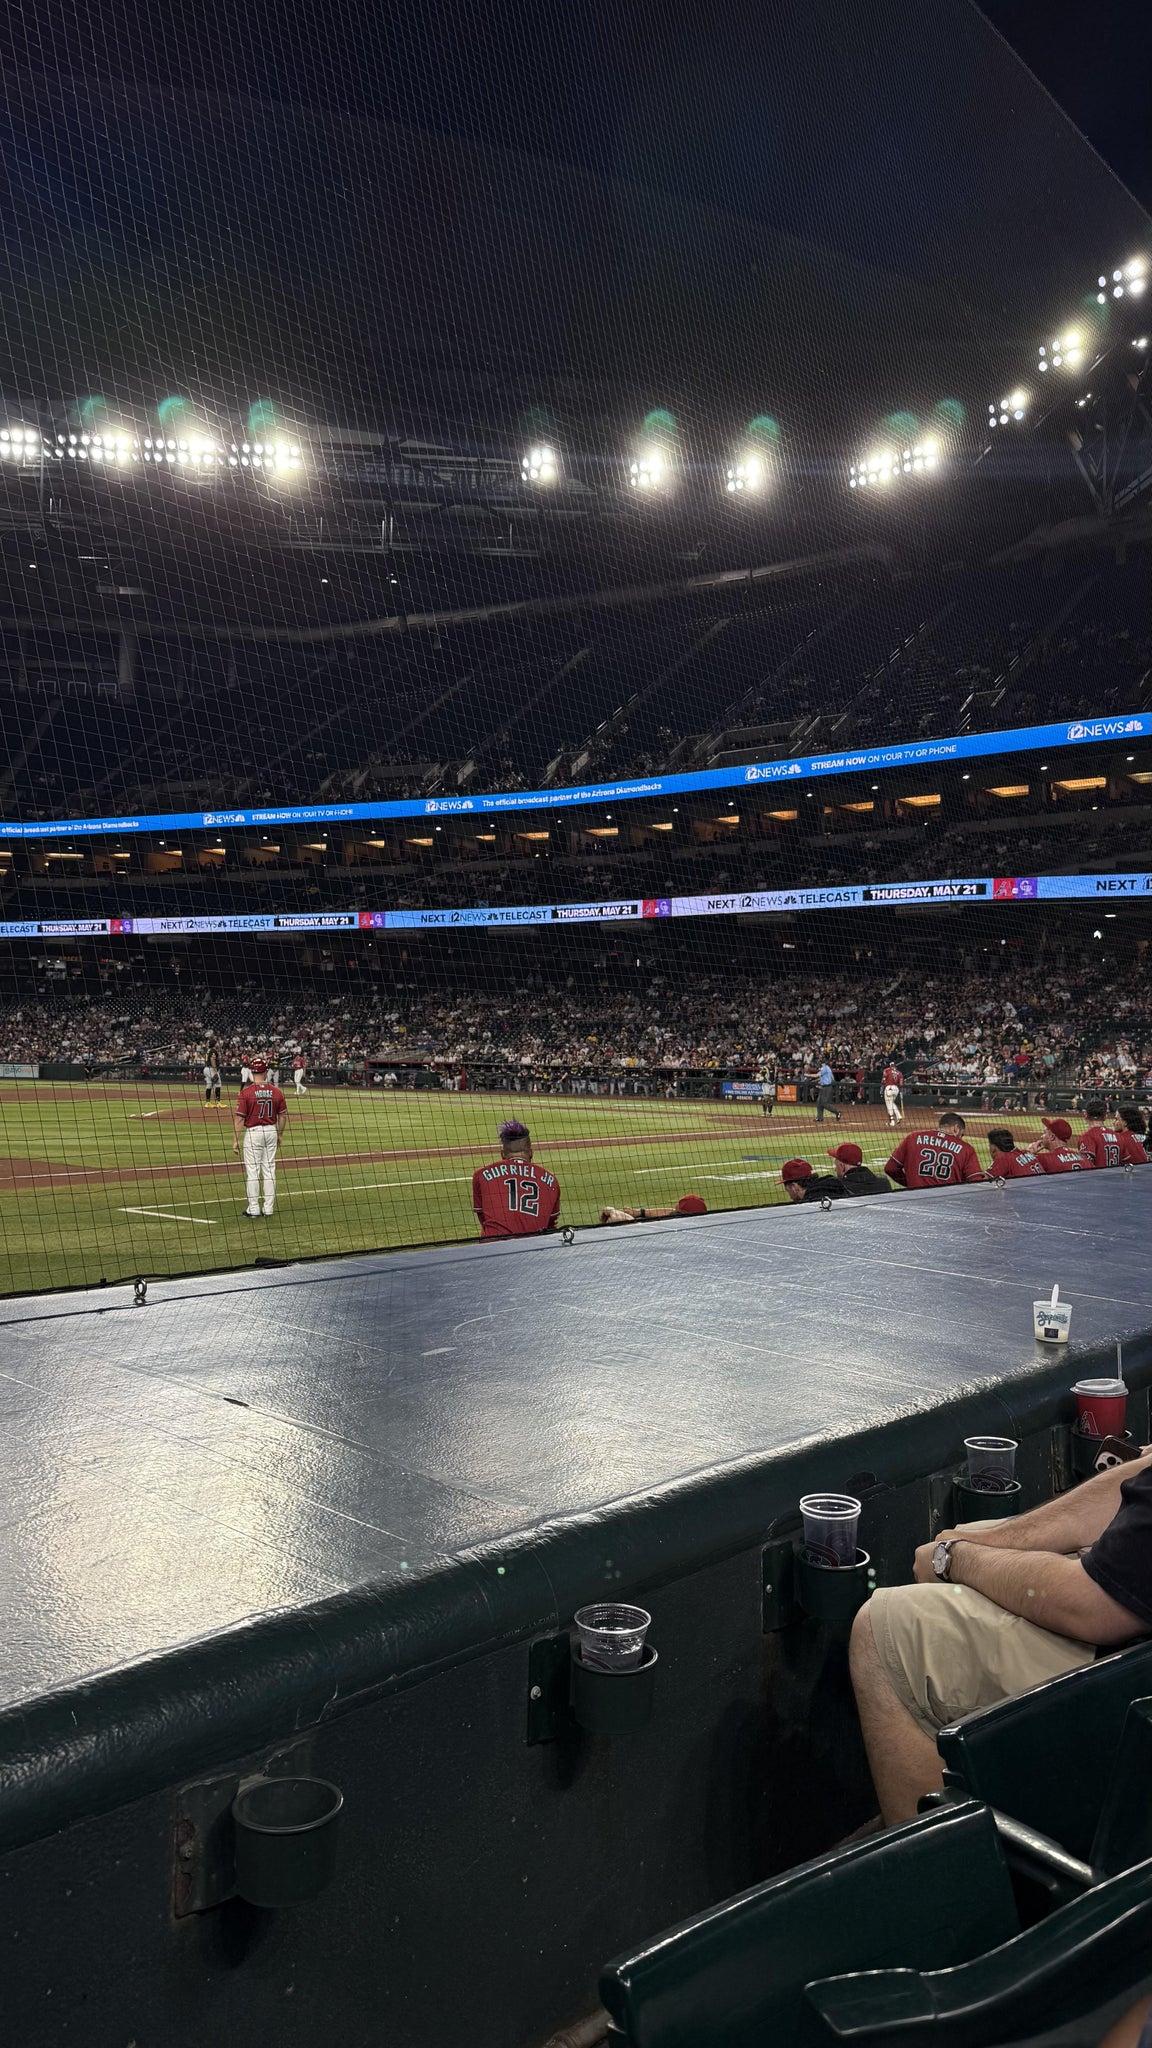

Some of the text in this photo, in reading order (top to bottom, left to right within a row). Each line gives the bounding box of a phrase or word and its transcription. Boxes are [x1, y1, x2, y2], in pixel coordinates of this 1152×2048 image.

[811, 759, 844, 771] STREAM
[846, 757, 867, 767] NOW
[867, 754, 880, 763] ON
[881, 752, 903, 762] YOUR
[903, 750, 915, 759] TV
[915, 749, 928, 758] OR
[928, 745, 957, 756] PHONE
[517, 796, 549, 805] broadcast
[549, 794, 572, 803] partner
[591, 789, 615, 797] Arizona
[616, 783, 662, 795] Diamondbacks
[252, 813, 276, 821] STREAM
[1096, 880, 1137, 891] NEXT
[708, 898, 735, 910] NEXT
[798, 891, 858, 904] TELECAST
[870, 888, 932, 900] THURSDAY,
[932, 885, 961, 896] MAY
[962, 884, 977, 895] 21
[160, 921, 182, 930] NEXT
[228, 918, 271, 929] TELECAST
[278, 917, 321, 927] THURSDAY,
[321, 917, 339, 926] MAY
[339, 916, 350, 925] 21
[420, 914, 446, 923] NEXT
[500, 910, 548, 921] TELECAST
[556, 907, 602, 918] THURSDAY,
[602, 906, 621, 916] MAY
[622, 906, 633, 915] 21
[257, 1099, 273, 1119] 71
[916, 1134, 963, 1154] ARENADO
[918, 1148, 955, 1180] 28
[1104, 1144, 1120, 1167] 13
[482, 1164, 537, 1182] GURRIEL
[503, 1177, 540, 1217] 12
